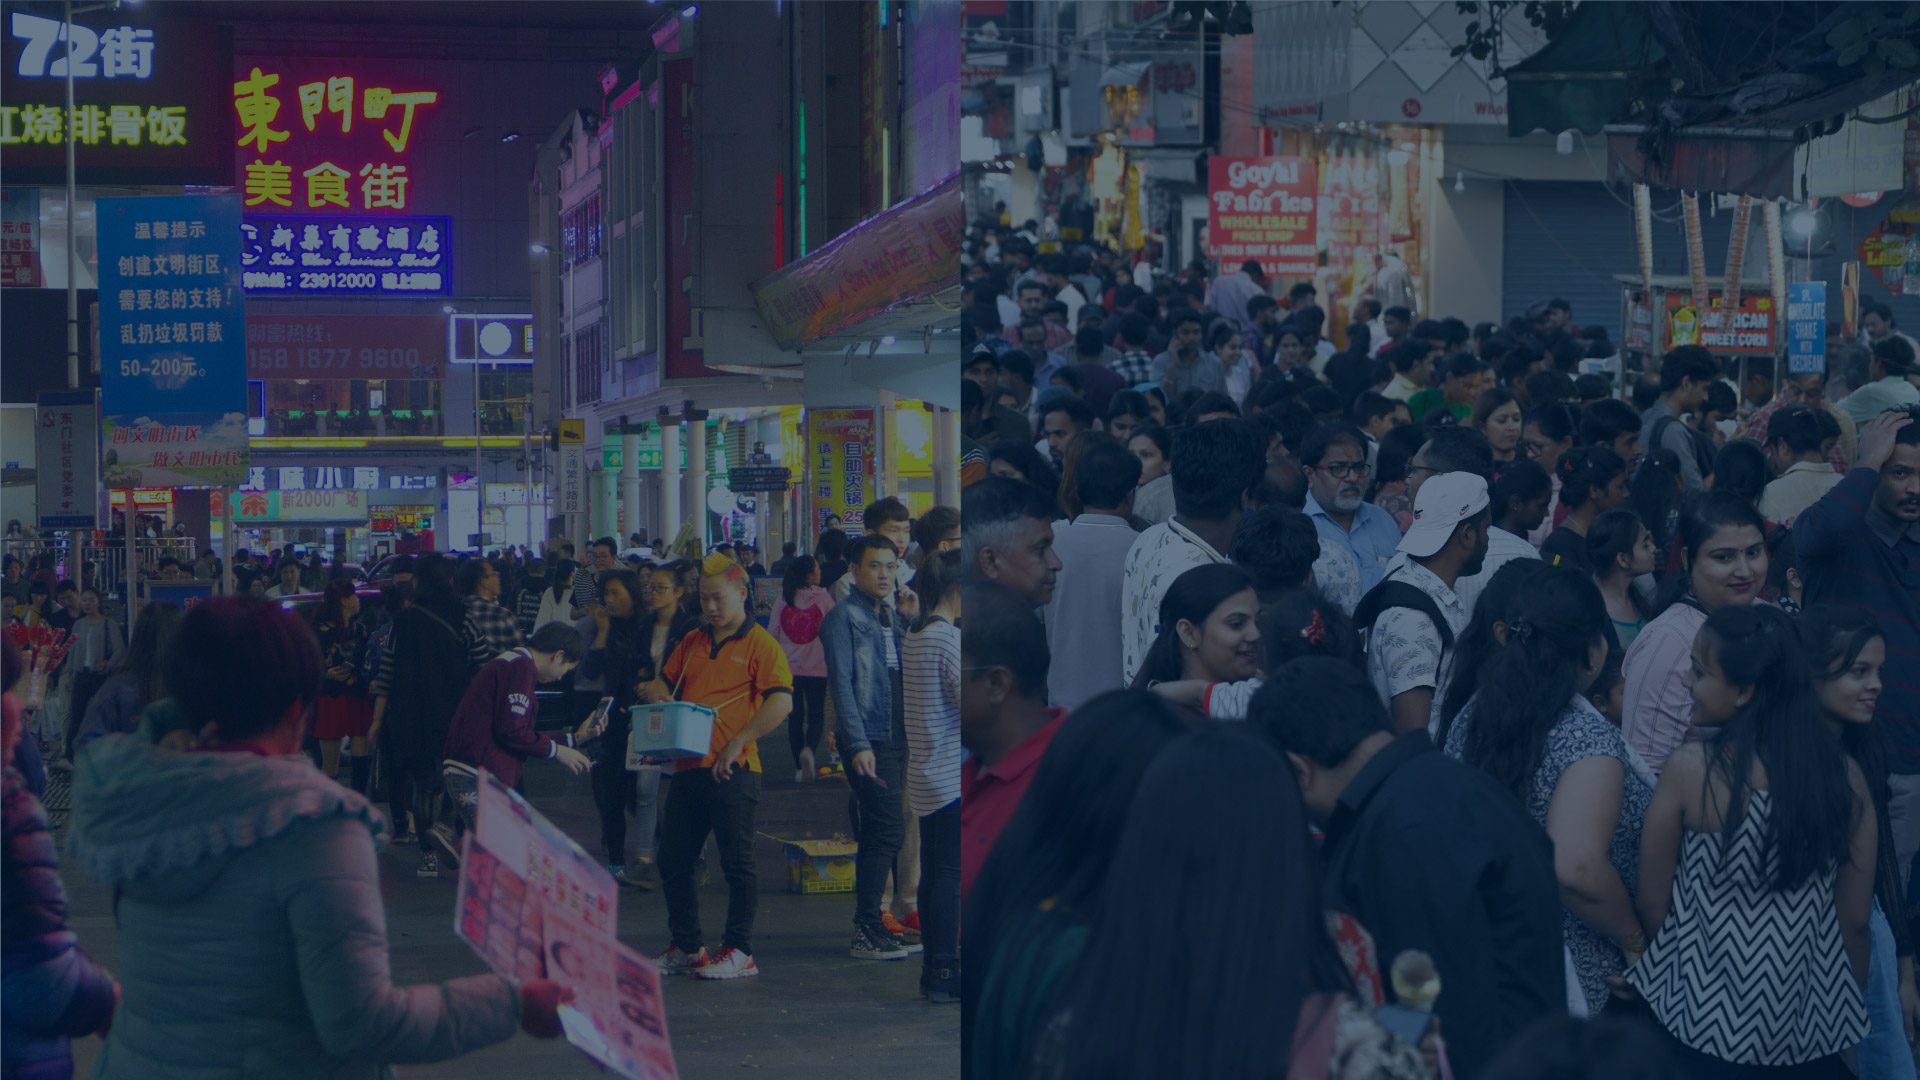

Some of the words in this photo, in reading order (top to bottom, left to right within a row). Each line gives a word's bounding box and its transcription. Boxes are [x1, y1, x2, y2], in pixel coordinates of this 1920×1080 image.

[12, 12, 155, 79] 72街
[233, 67, 438, 153] 東門町
[245, 159, 408, 209] 美食街
[1228, 161, 1299, 189] Goyal
[1213, 189, 1314, 213] Fabrics
[134, 221, 206, 240] 温馨提示
[1219, 216, 1308, 230] WHOLESALE
[1232, 231, 1264, 242] PRICE
[1265, 231, 1295, 242] SHOP
[118, 254, 229, 277] 创建文明街区，
[299, 272, 376, 288] 23912000
[119, 287, 232, 311] 需要您的支持！
[120, 320, 223, 345] 乱扔垃圾罚款
[1701, 332, 1736, 347] SWEET
[1738, 332, 1770, 347] CORN
[1795, 321, 1818, 339] SHAKE
[247, 348, 288, 369] 158
[297, 348, 352, 369] 1877
[359, 348, 419, 369] 9600
[1790, 354, 1824, 372] ICECREAM
[112, 425, 202, 444] 创文明街区
[60, 412, 74, 497] 东门社区党委
[152, 449, 241, 468] 做文明市民
[566, 447, 579, 511] 交通繁忙路段
[818, 441, 833, 498] 请上二楼
[844, 440, 864, 507] 自助火锅
[281, 491, 359, 510] 新2000广场
[843, 509, 865, 524] 25
